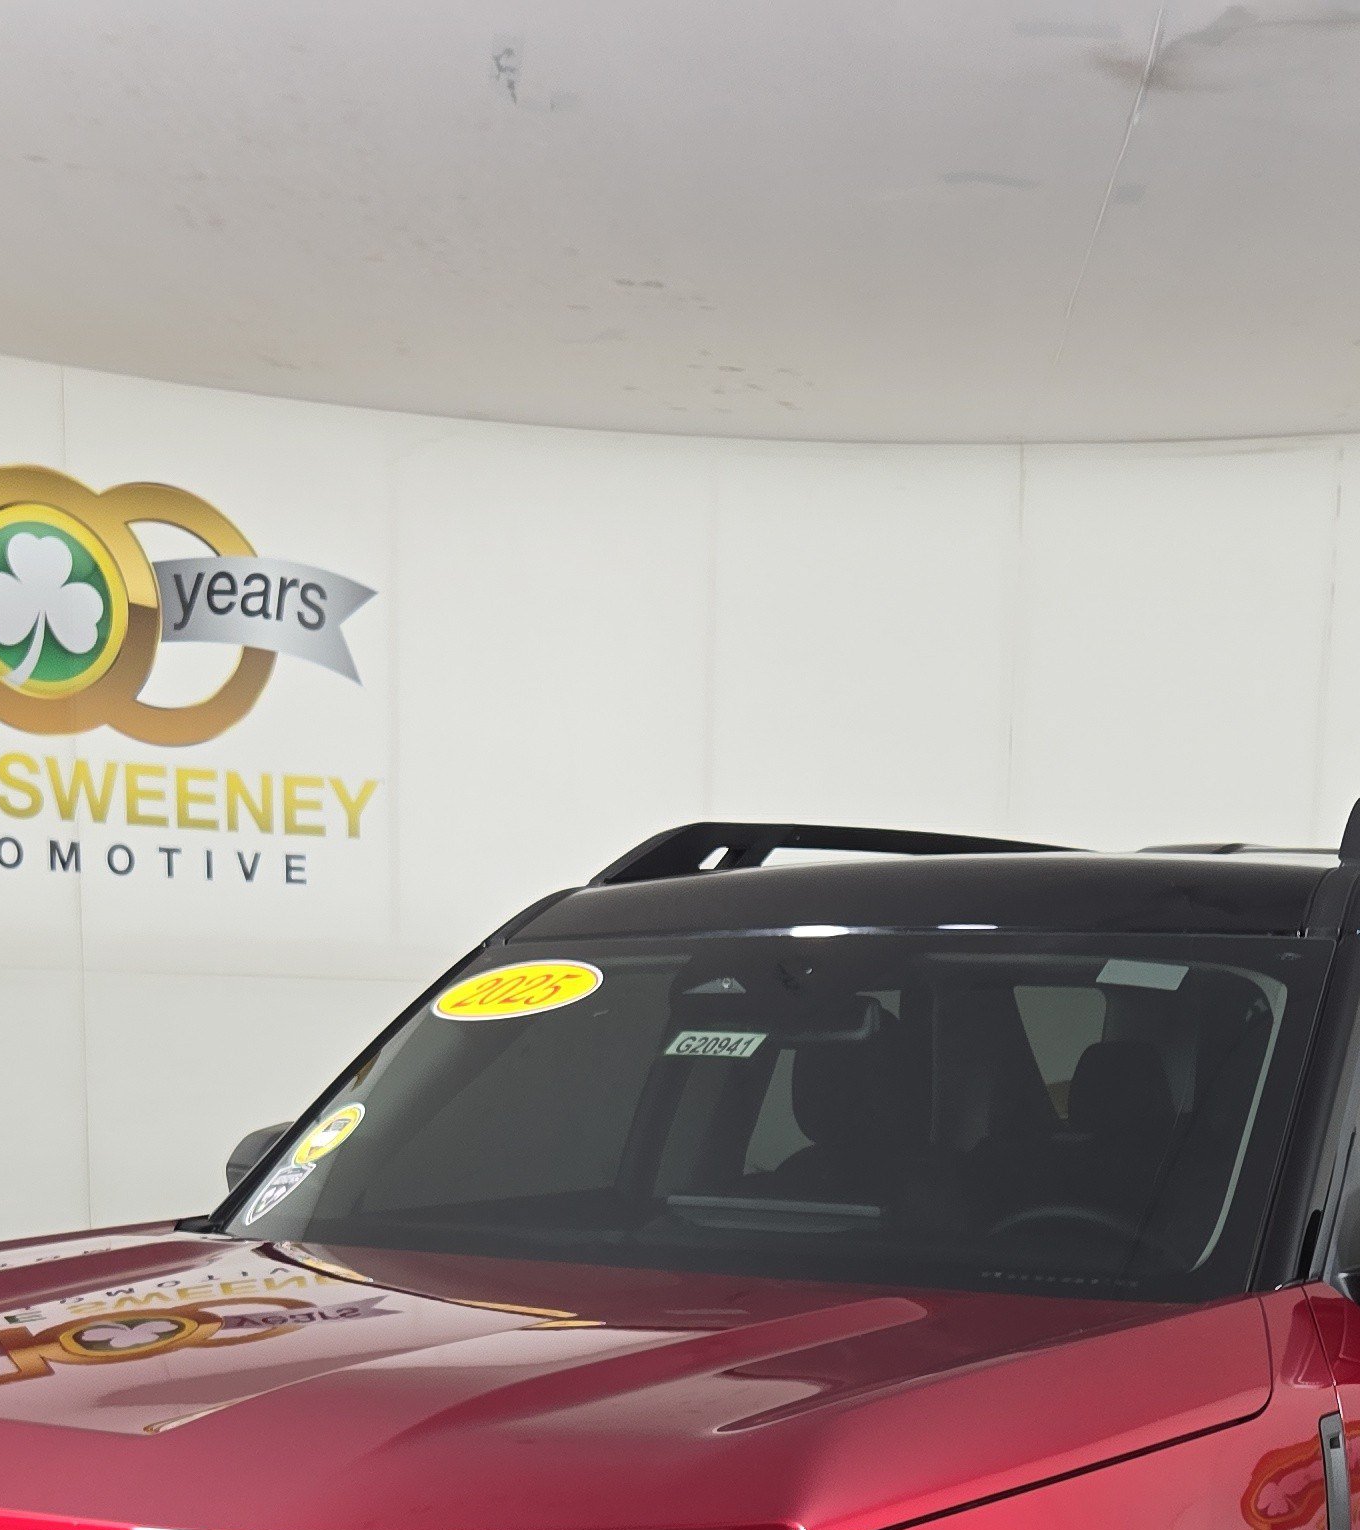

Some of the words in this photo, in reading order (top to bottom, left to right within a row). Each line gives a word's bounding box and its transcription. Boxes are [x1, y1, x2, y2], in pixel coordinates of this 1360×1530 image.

[171, 566, 329, 632] years
[449, 973, 583, 1009] 2025
[675, 1035, 756, 1056] G20941
